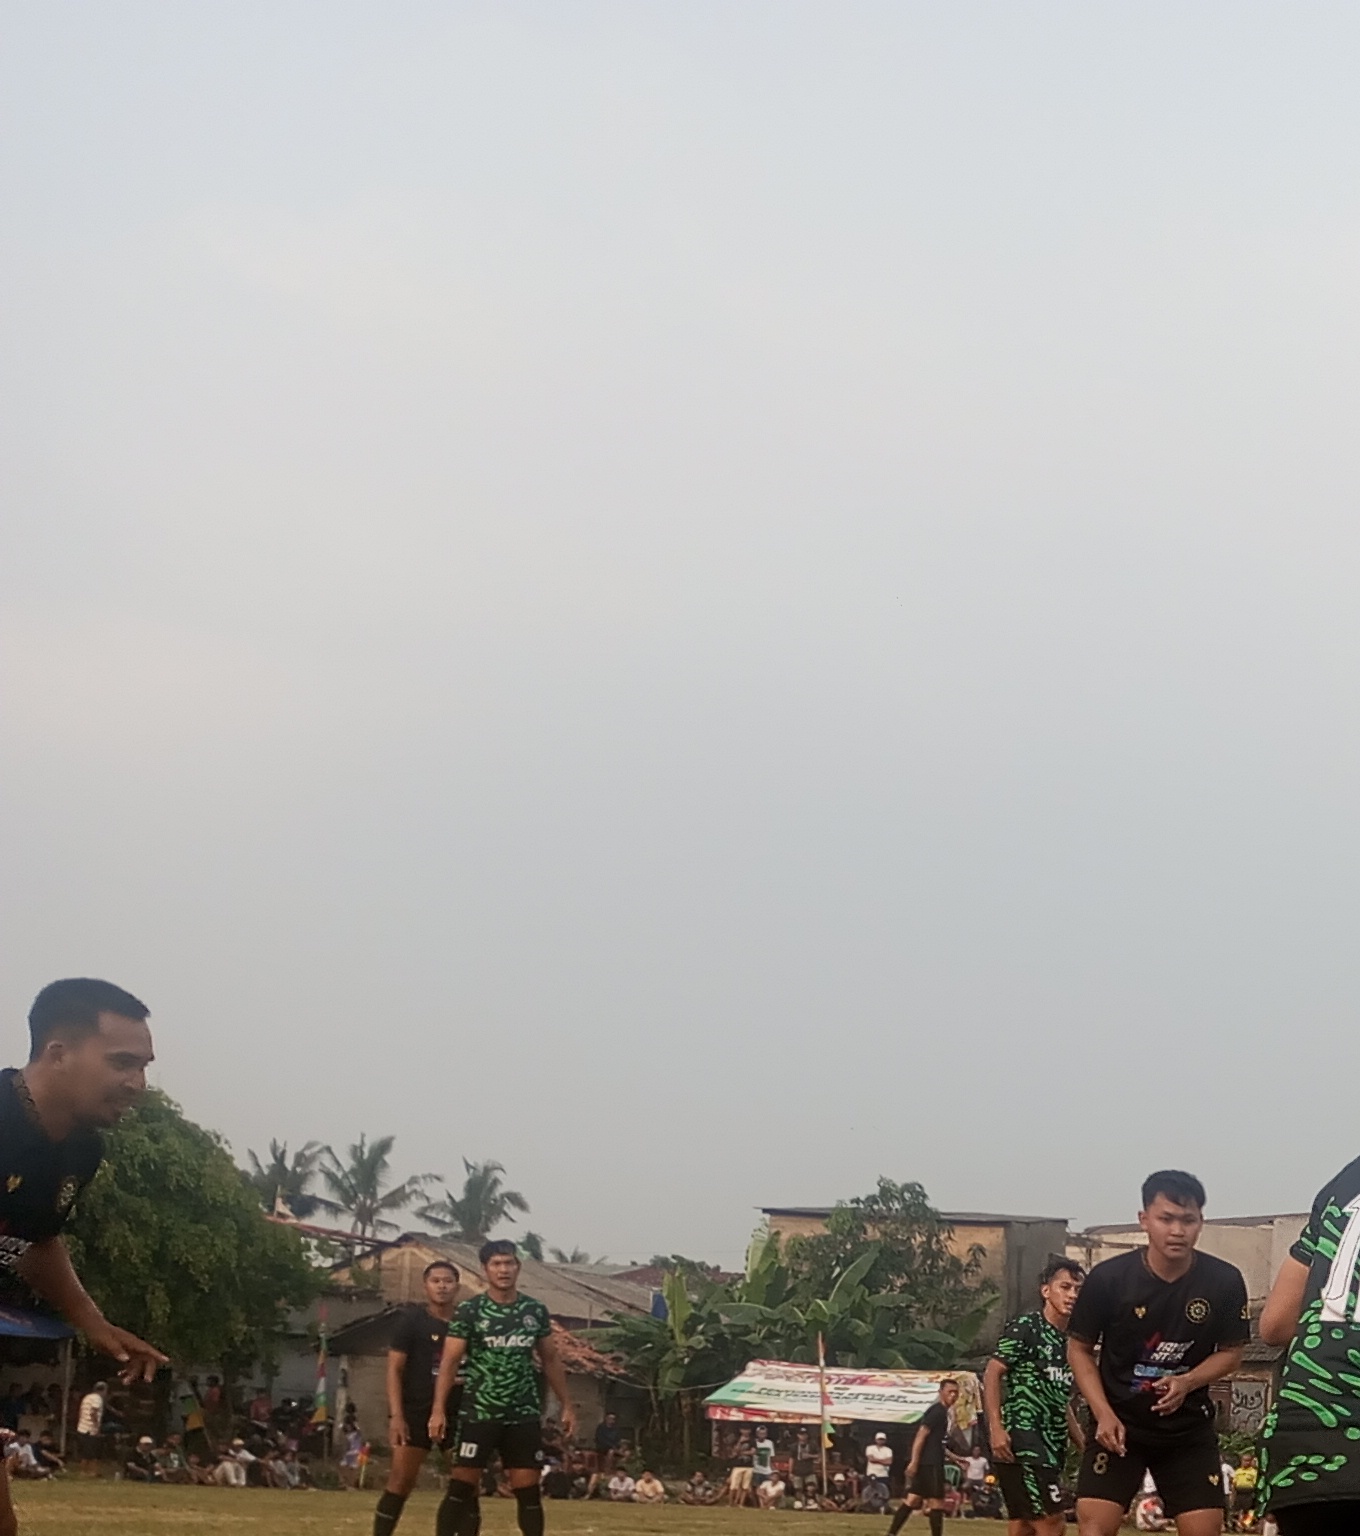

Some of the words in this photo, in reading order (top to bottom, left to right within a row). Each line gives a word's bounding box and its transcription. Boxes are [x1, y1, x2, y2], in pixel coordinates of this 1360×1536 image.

[484, 1334, 535, 1348] THIAGO
[459, 1441, 478, 1459] 10
[1093, 1452, 1109, 1475] 8
